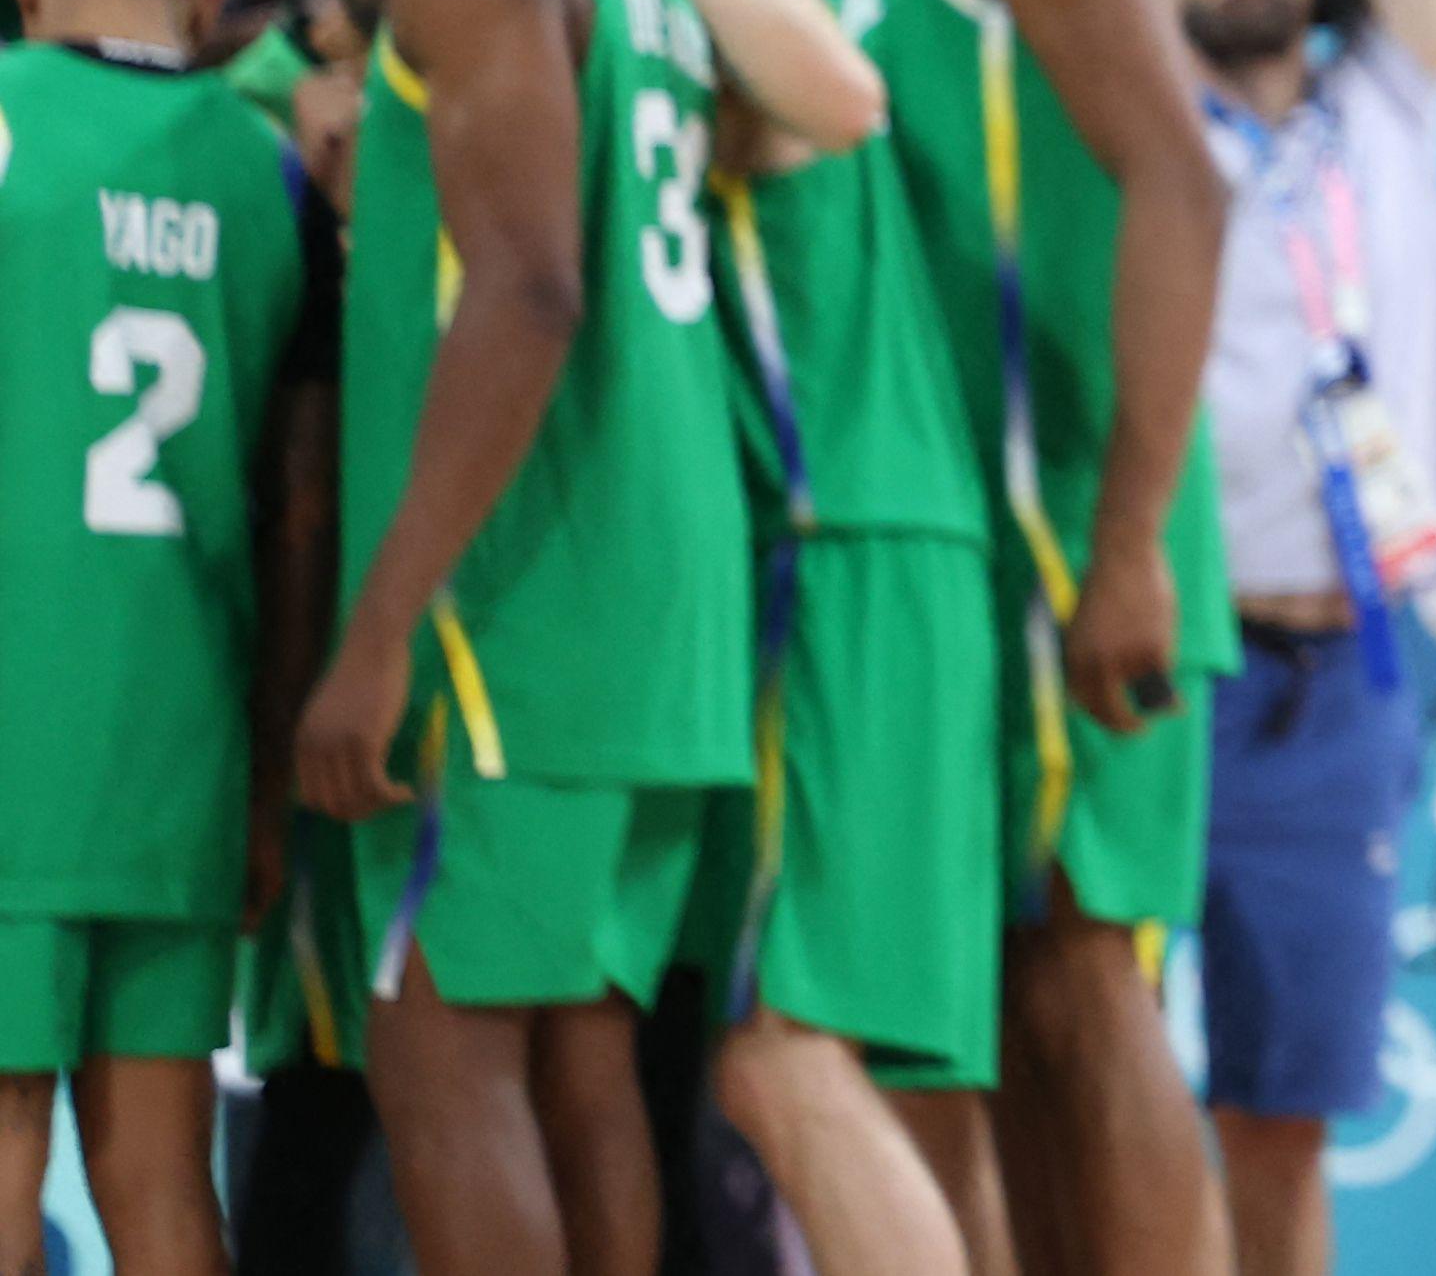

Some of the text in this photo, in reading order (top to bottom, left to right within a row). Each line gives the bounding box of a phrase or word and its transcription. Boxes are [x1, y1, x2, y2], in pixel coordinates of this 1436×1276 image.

[98, 187, 220, 282] YAGO
[633, 88, 714, 324] 3
[84, 304, 207, 537] 2
